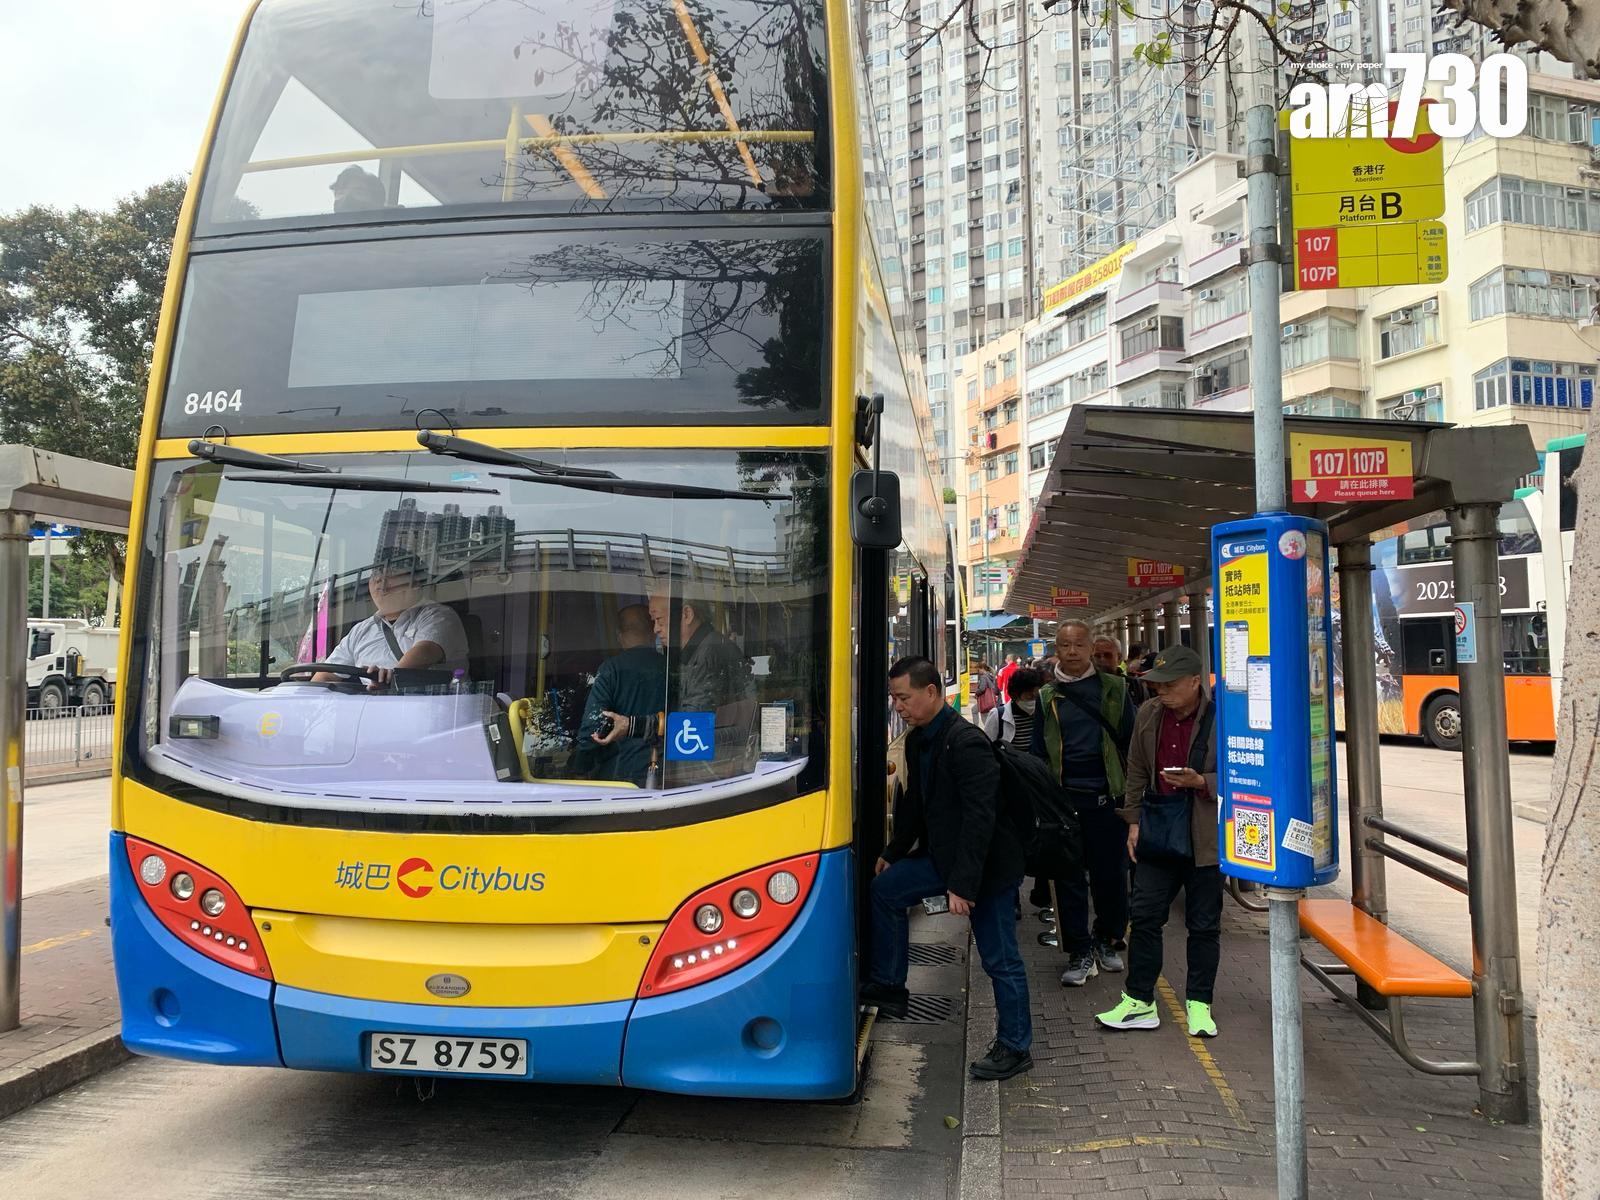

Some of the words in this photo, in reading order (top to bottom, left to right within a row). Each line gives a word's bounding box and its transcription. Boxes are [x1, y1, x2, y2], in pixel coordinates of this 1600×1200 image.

[1352, 164, 1386, 176] 香港仔
[1339, 194, 1376, 214] 月台
[1381, 192, 1403, 219] B
[1340, 213, 1376, 222] Platform
[1305, 236, 1331, 253] 107
[1301, 265, 1337, 282] 107P
[184, 389, 243, 415] 8464
[1314, 452, 1344, 474] 107
[1353, 450, 1385, 473] 107P
[1340, 479, 1389, 490] 請在此排隊
[1246, 544, 1265, 552] Citybus
[1139, 563, 1153, 575] 107
[1225, 583, 1260, 597] 抵站時間
[1228, 750, 1264, 766] 抵站時間
[1290, 832, 1306, 842] LED
[334, 860, 392, 890] 城巴
[439, 865, 546, 894] Citybus
[377, 1037, 418, 1066] SZ
[433, 1040, 520, 1070] 8759
